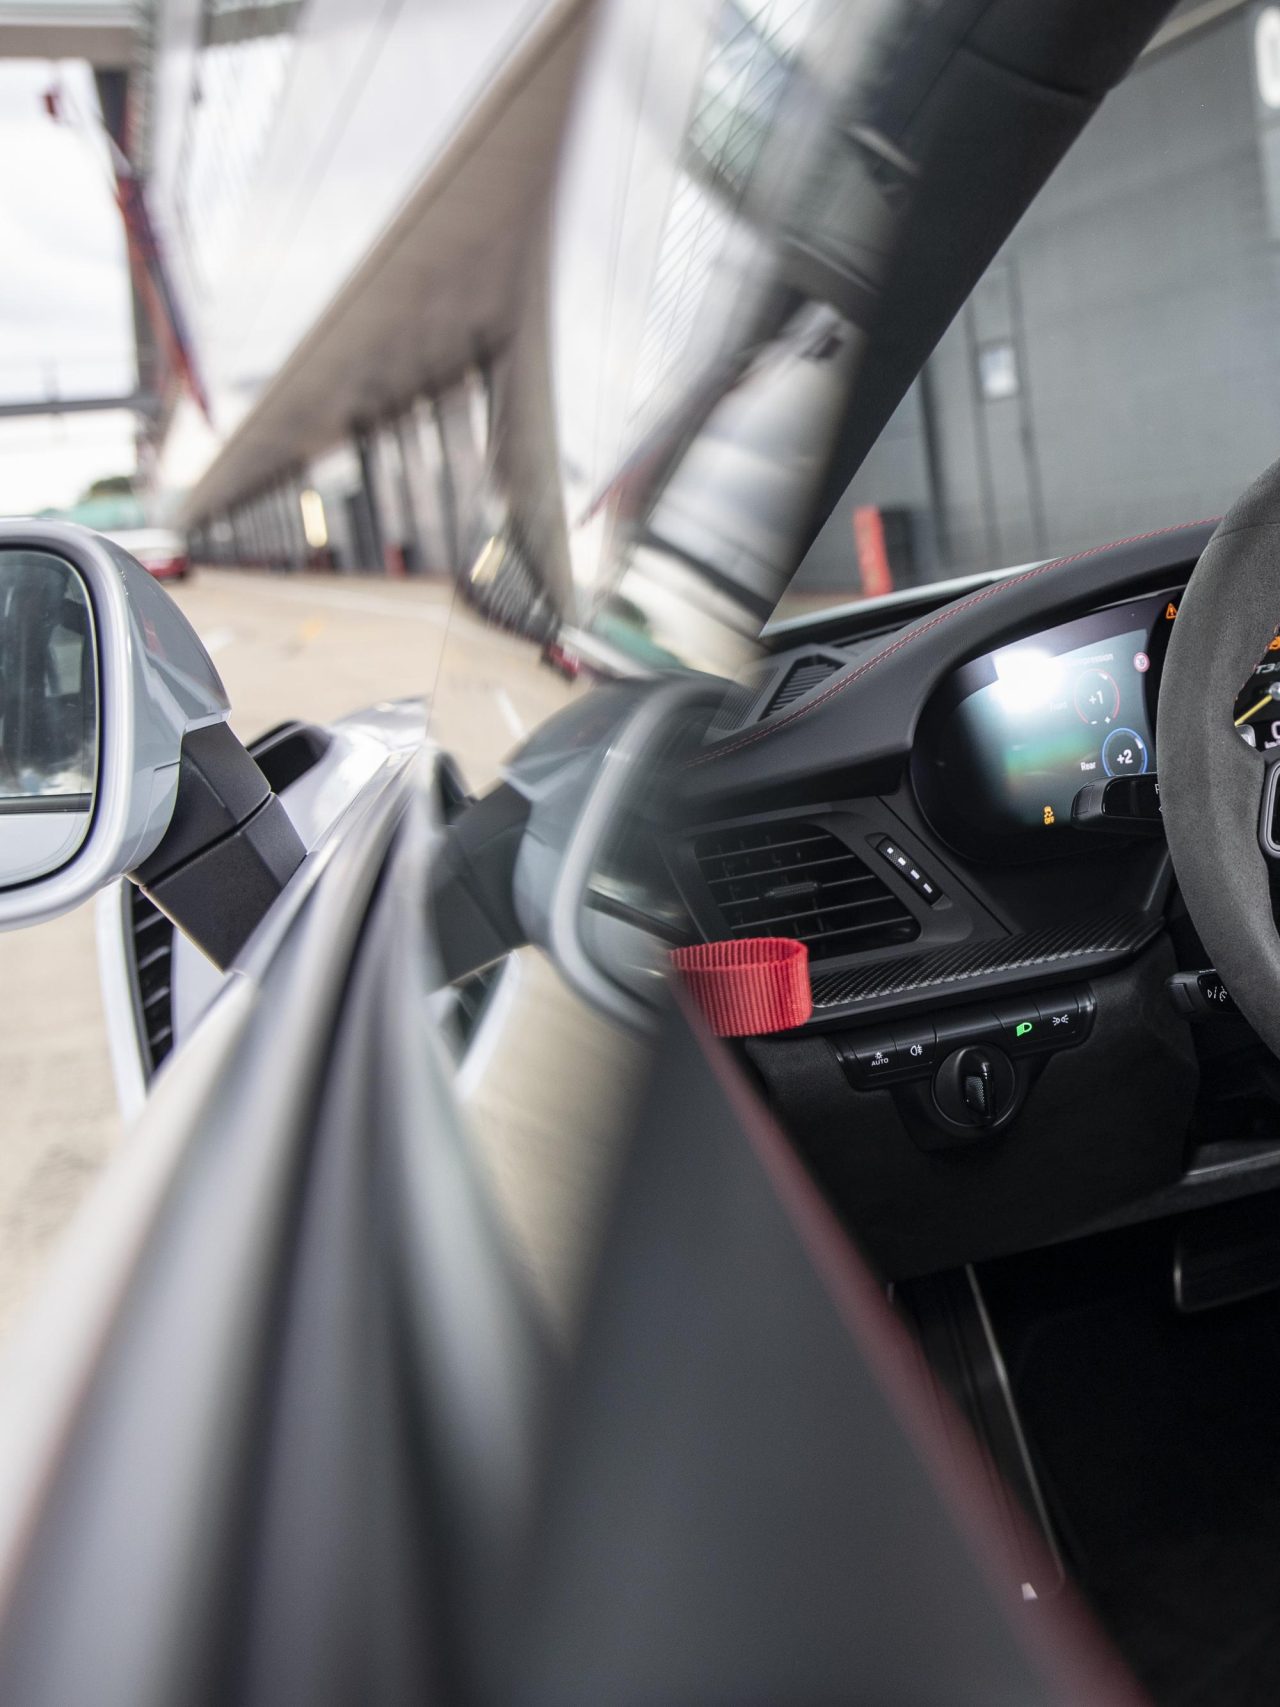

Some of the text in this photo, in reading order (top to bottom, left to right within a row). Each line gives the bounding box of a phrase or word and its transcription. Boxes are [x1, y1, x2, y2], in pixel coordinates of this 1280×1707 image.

[1088, 689, 1104, 705] +1
[1116, 749, 1133, 764] +2
[1080, 761, 1096, 771] Rear
[871, 1057, 889, 1067] AUTO
